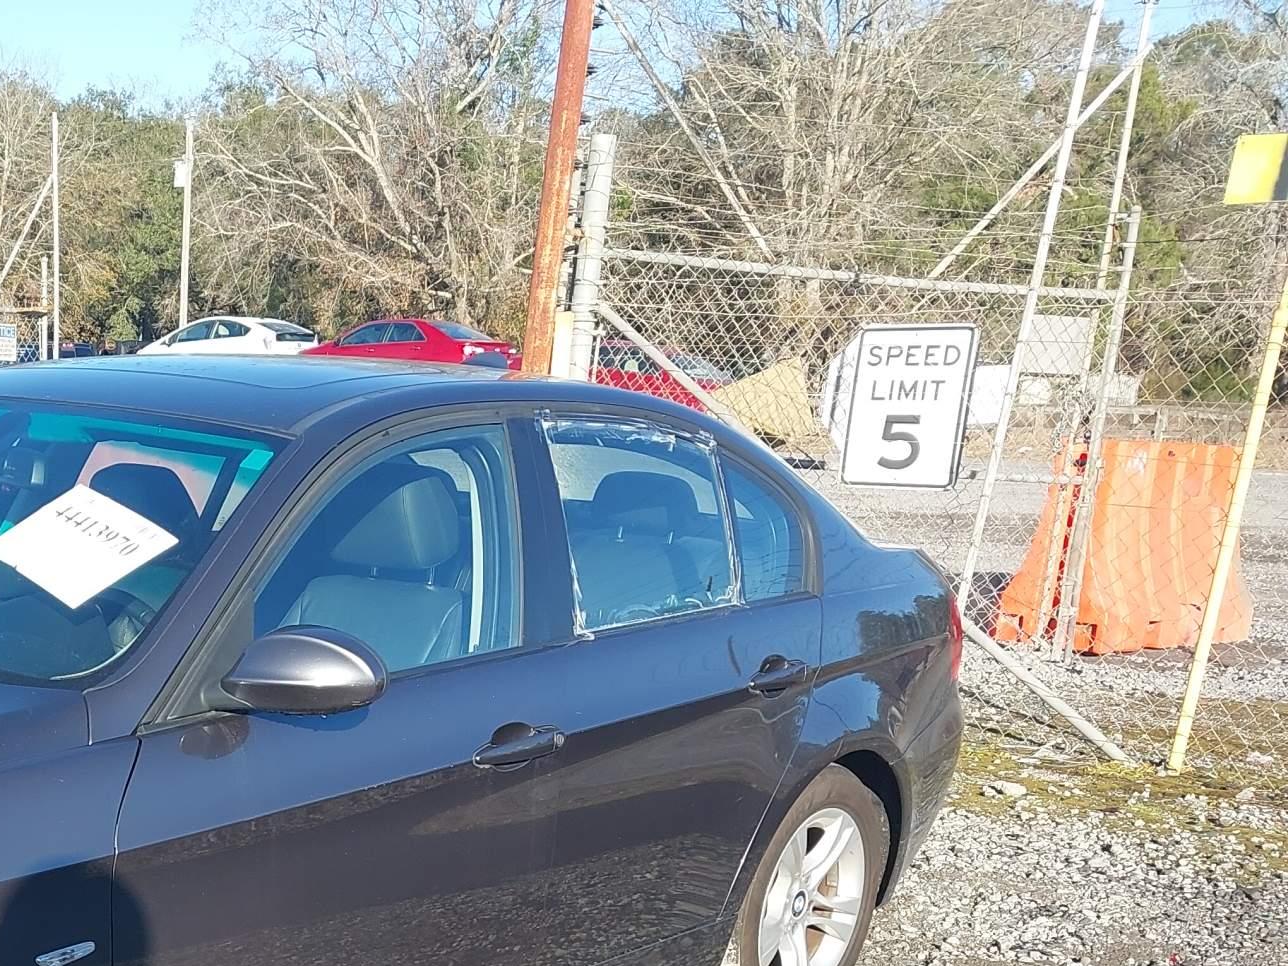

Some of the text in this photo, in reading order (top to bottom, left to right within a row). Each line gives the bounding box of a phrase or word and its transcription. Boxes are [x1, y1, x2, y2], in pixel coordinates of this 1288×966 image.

[867, 345, 961, 366] SPEED
[871, 380, 946, 401] LIMIT
[877, 415, 921, 469] 5
